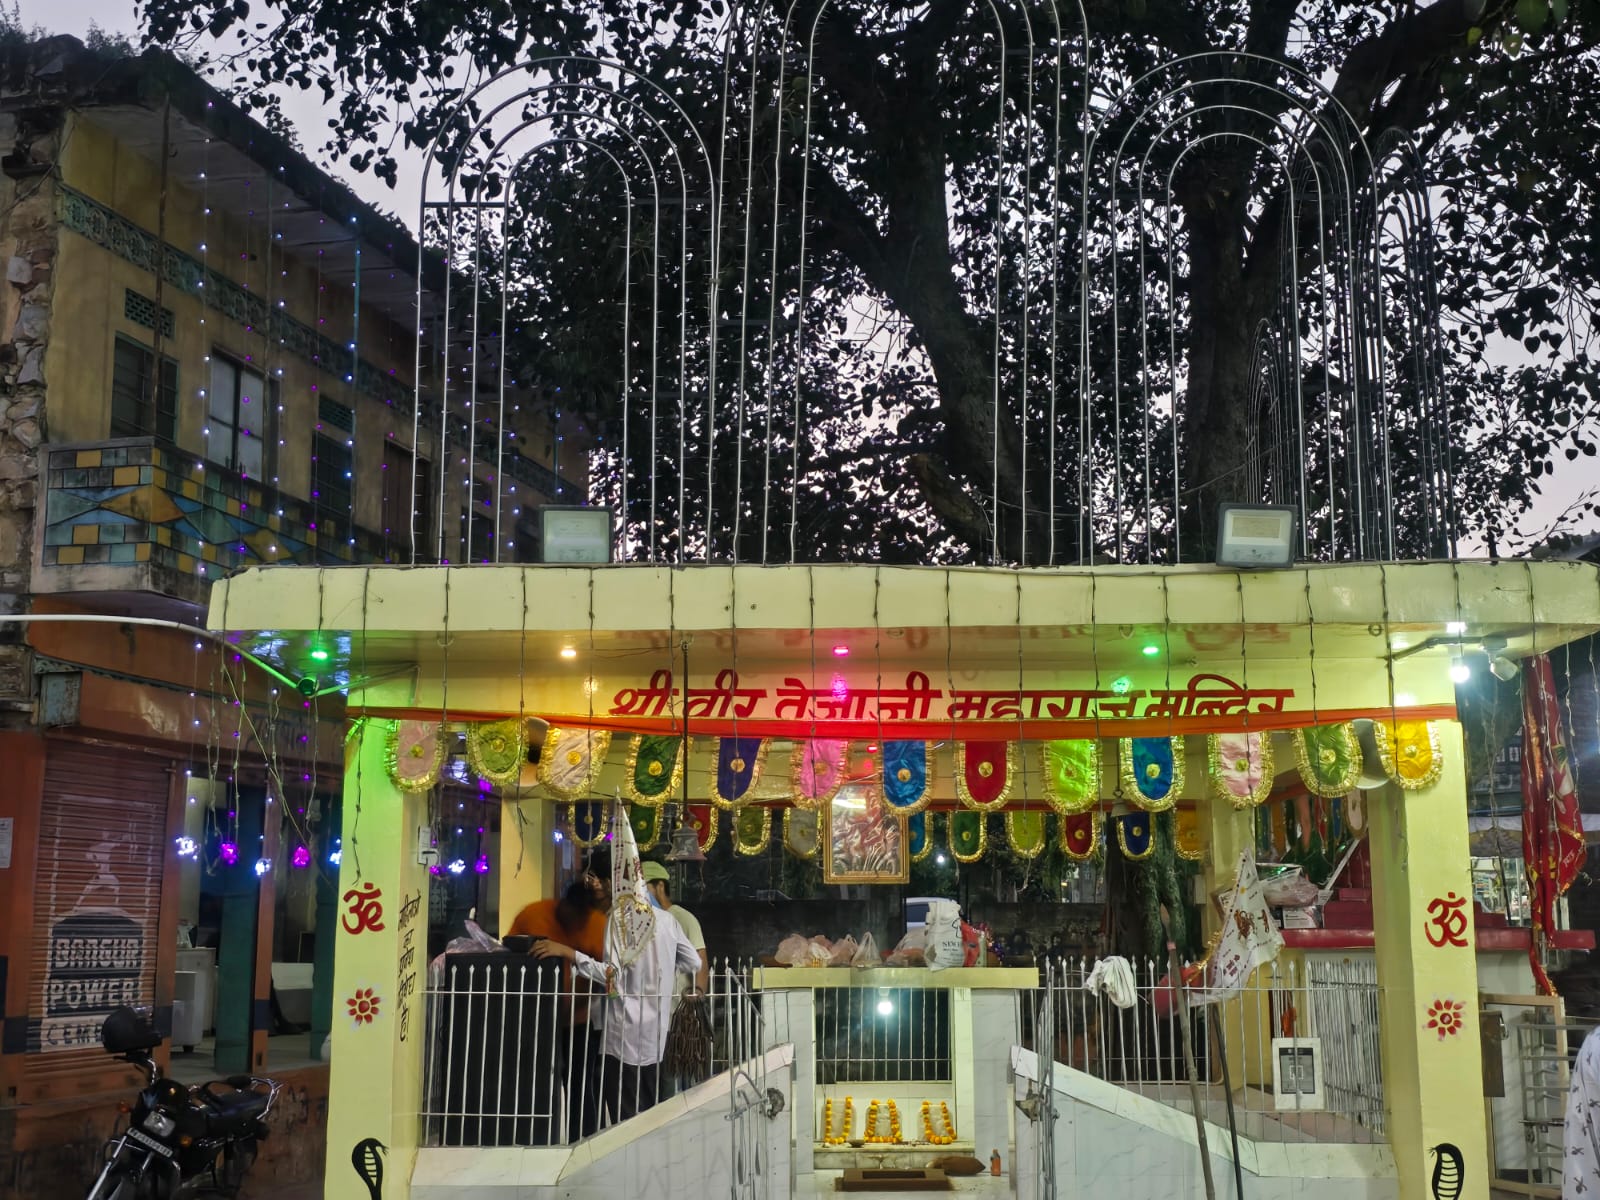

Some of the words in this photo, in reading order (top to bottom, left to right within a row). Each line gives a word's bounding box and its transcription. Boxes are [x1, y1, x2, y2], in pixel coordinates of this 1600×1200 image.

[608, 669, 679, 715] श्री
[687, 669, 768, 718] वीर
[774, 677, 943, 720] तेजाजी
[947, 689, 1146, 719] महाराज
[49, 979, 138, 1010] POWER
